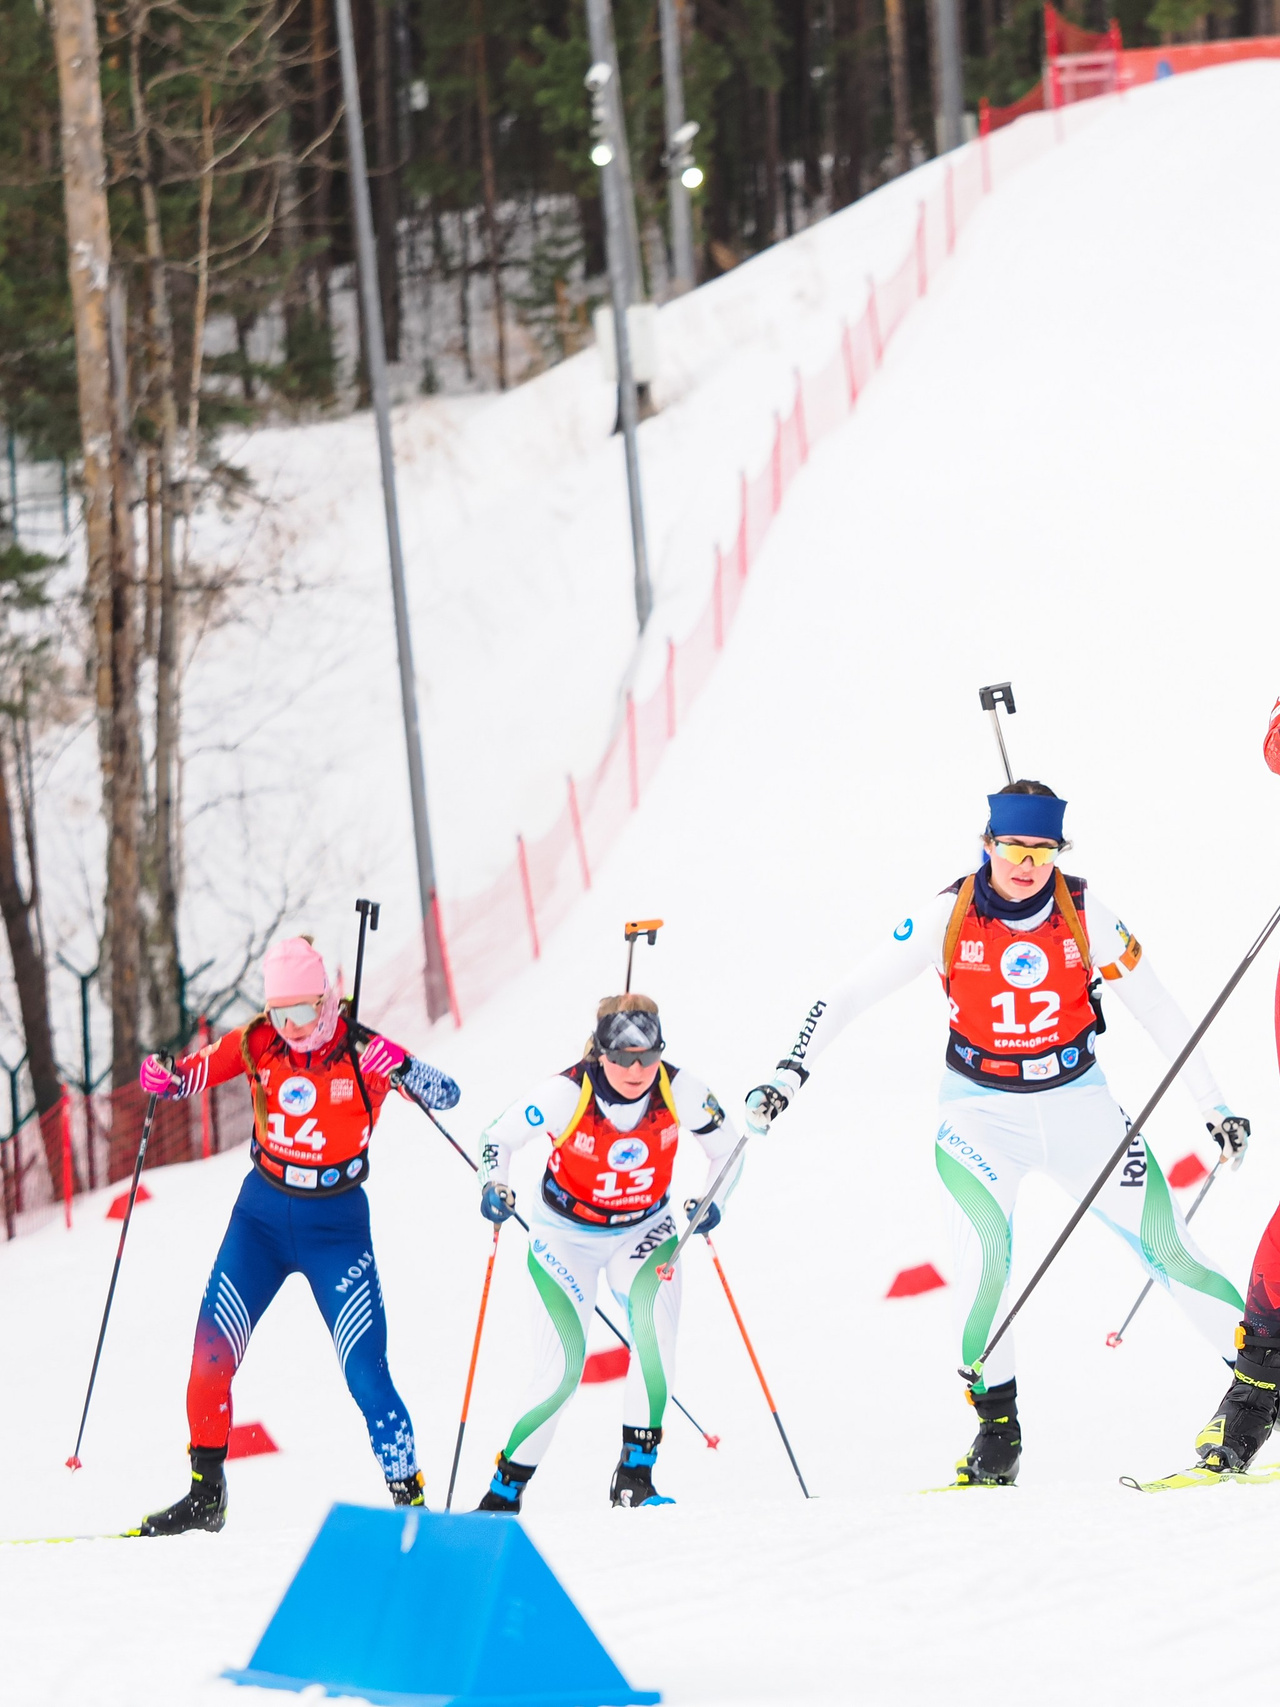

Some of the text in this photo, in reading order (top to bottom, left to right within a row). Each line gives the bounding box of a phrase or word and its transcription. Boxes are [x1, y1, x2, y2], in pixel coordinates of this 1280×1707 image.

[991, 990, 1061, 1034] 12
[994, 1032, 1060, 1048] КРАСНОЯРСК
[267, 1113, 326, 1151] 14
[269, 1143, 323, 1161] КРАСНОЯРСК
[946, 1133, 998, 1181] ЮГОРИЯ
[592, 1167, 656, 1199] 13
[544, 1252, 585, 1302] ЮГОРИЯ
